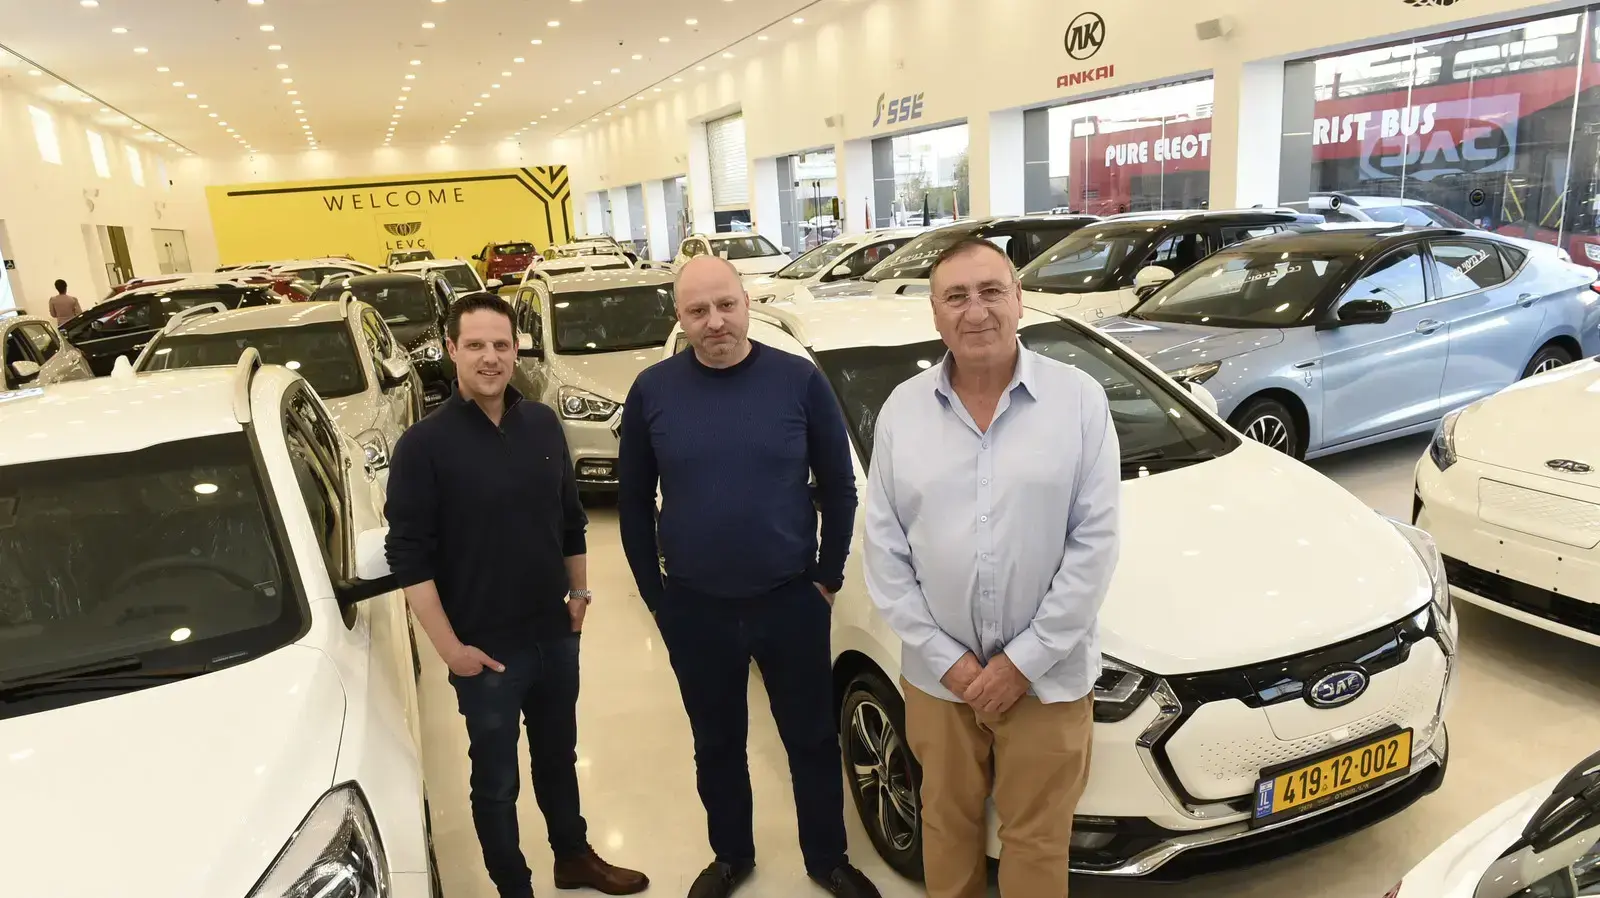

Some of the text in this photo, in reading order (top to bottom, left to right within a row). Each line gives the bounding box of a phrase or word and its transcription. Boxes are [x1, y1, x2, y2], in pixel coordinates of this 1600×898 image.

[1057, 64, 1114, 88] ANKAI
[1313, 103, 1437, 146] RIST BUS
[1105, 141, 1148, 167] PURE
[323, 187, 465, 212] WELCOME
[386, 238, 426, 250] LEVC
[1260, 791, 1270, 807] IL
